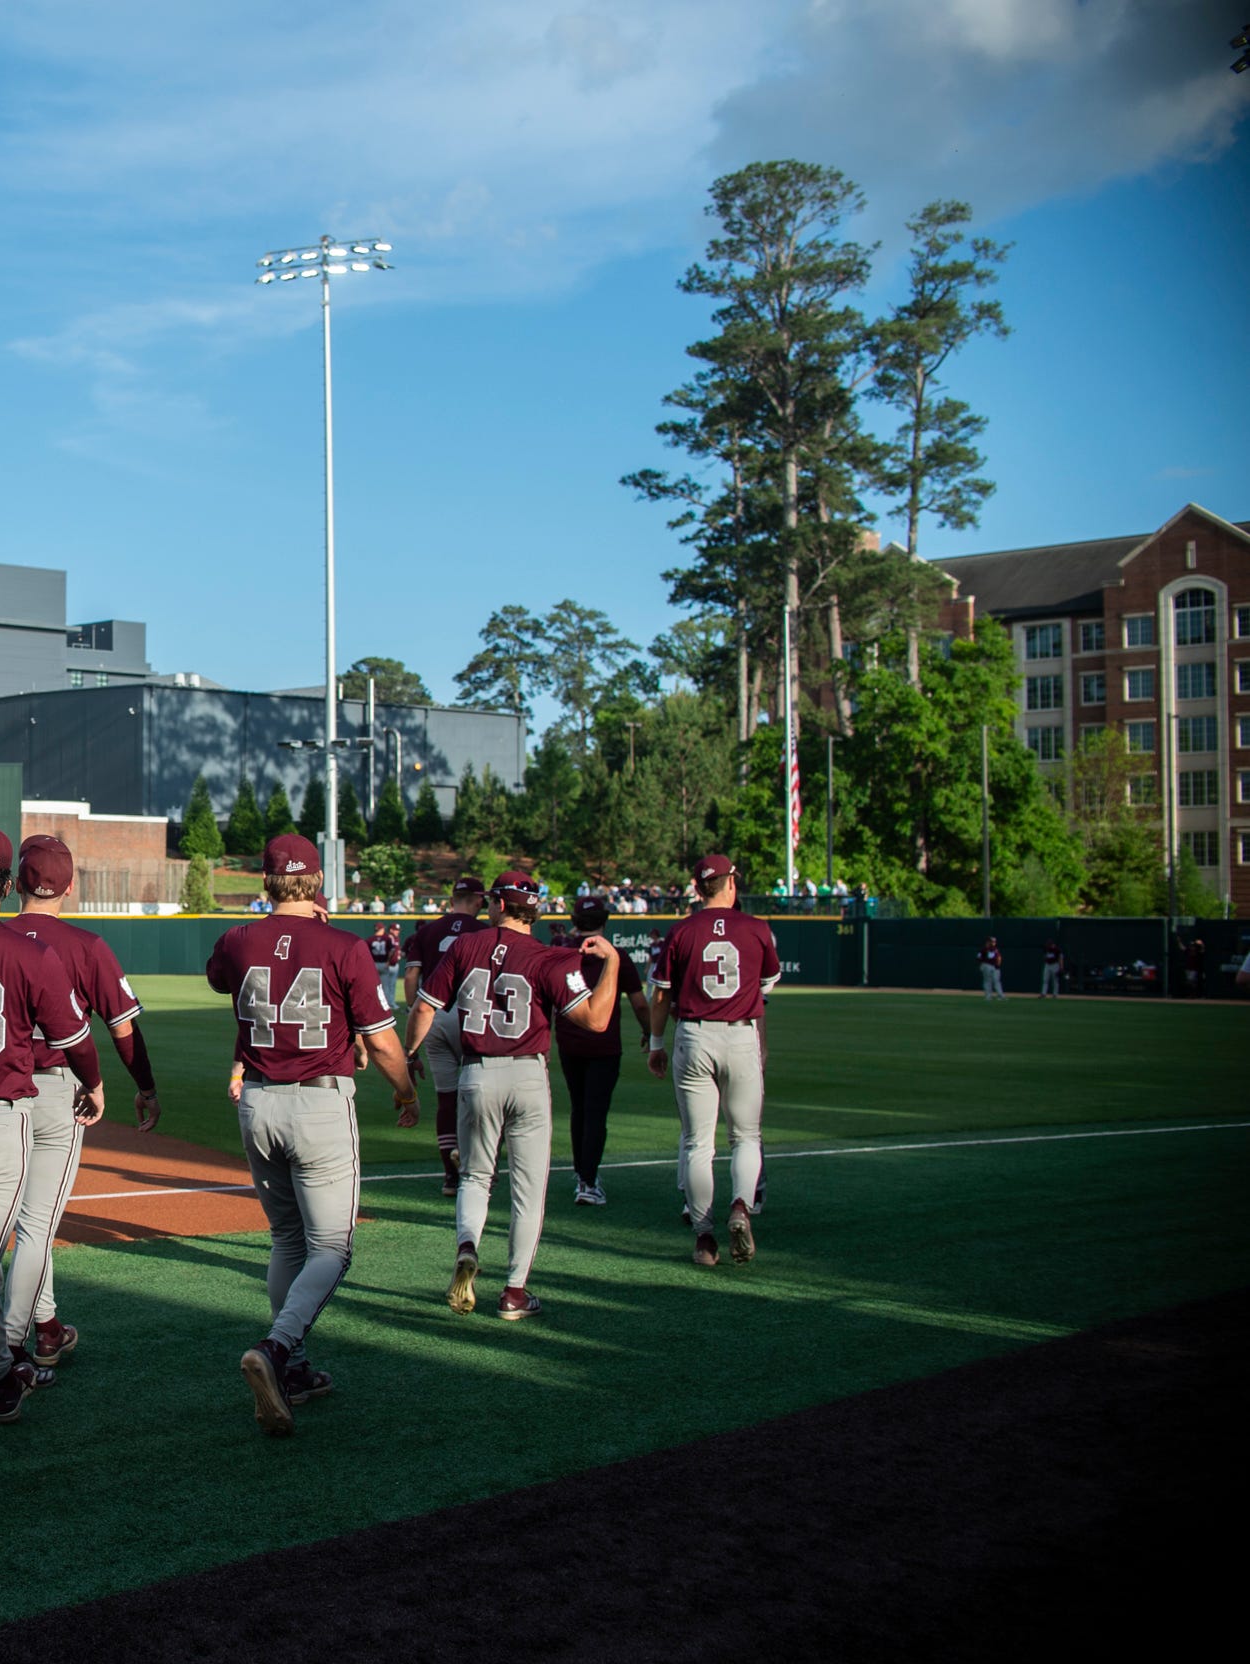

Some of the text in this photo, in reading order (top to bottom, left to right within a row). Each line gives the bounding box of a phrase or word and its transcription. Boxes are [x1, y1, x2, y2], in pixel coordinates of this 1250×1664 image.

[612, 933, 635, 948] East
[779, 961, 800, 972] EEK
[701, 941, 740, 999] 3
[238, 966, 331, 1049] 44
[456, 967, 532, 1040] 43
